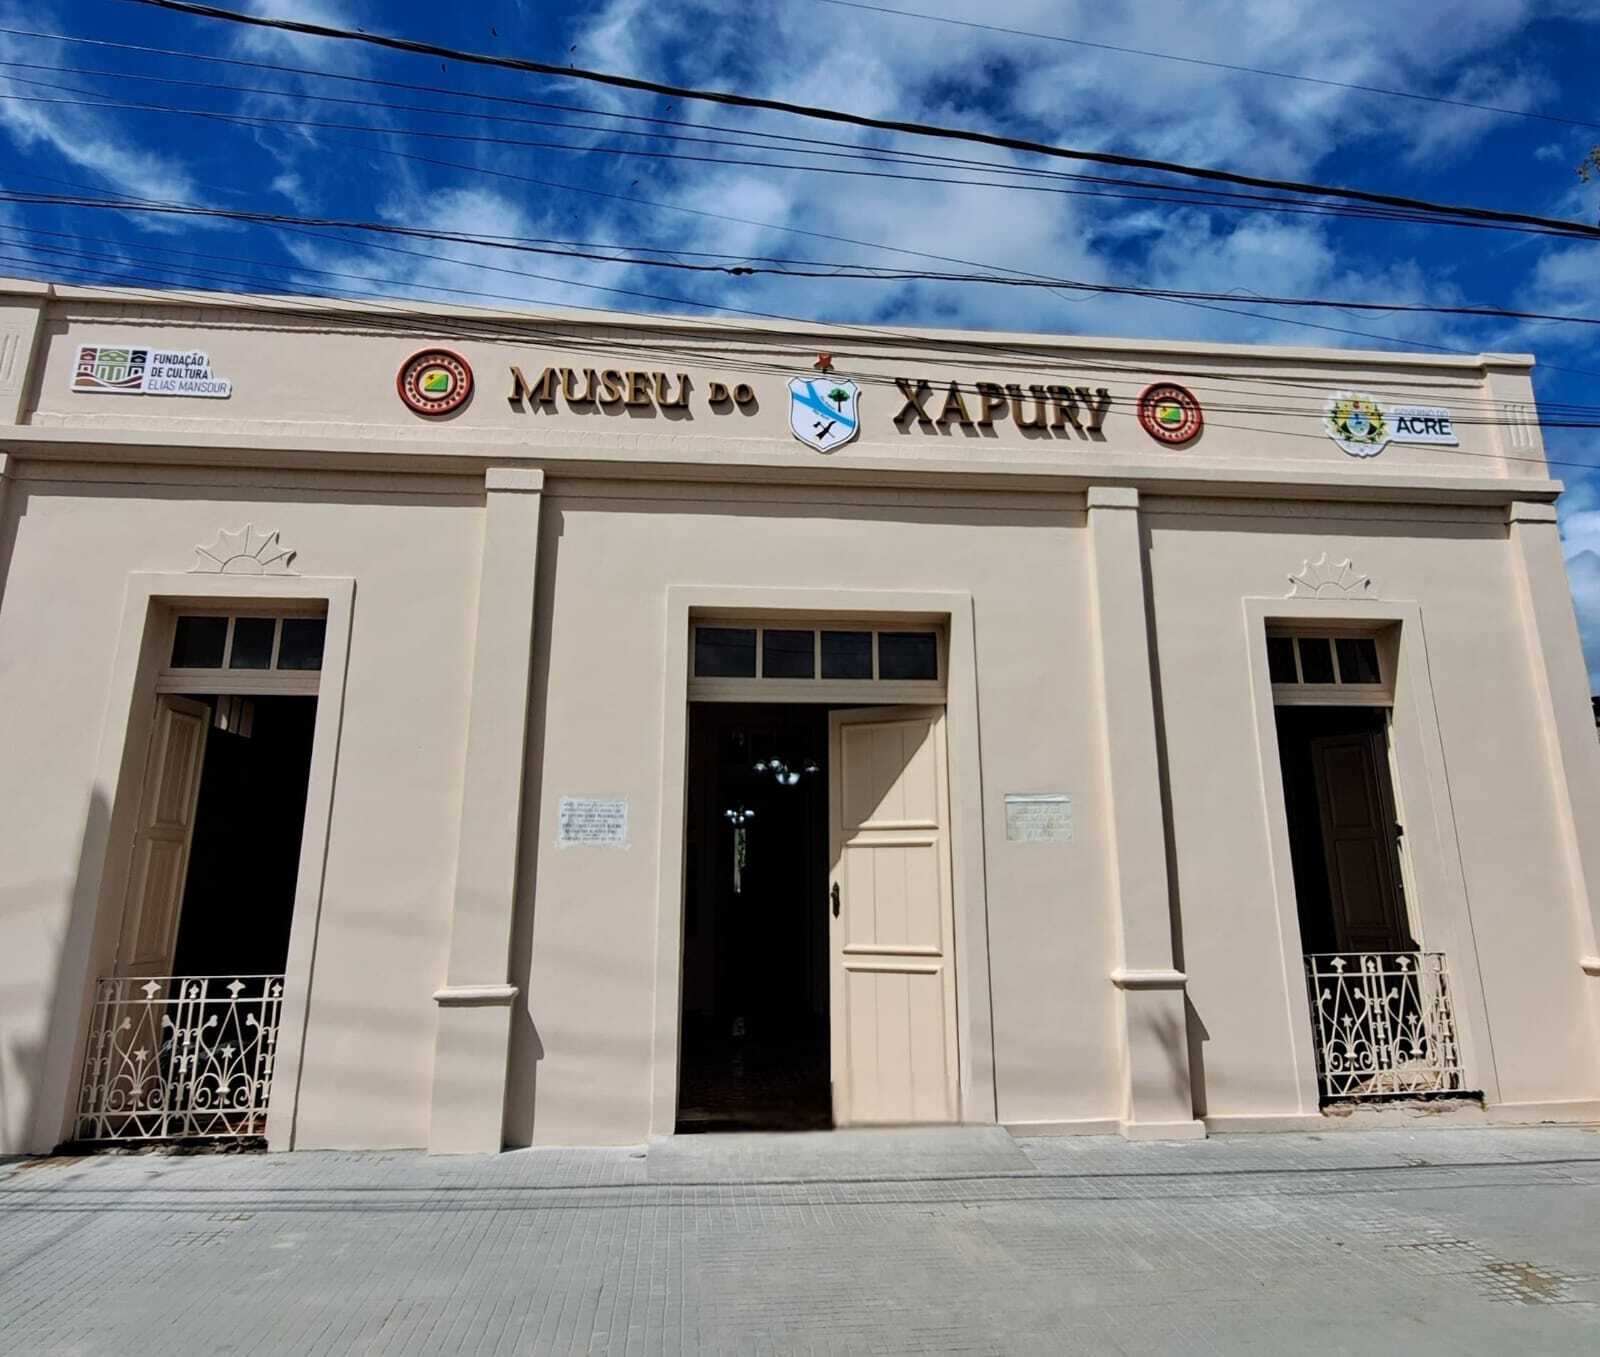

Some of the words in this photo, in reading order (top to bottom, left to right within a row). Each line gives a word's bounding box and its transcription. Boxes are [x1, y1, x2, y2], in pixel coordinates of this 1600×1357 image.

[153, 353, 204, 367] FUNDAÇÃO
[151, 367, 163, 378] DE
[166, 368, 208, 379] CULTURA
[147, 380, 176, 391] ELIAS
[178, 382, 227, 393] MANSOUR
[508, 366, 690, 407] MUSEU
[709, 383, 756, 405] DO
[893, 377, 1112, 433] XAPURY
[1396, 416, 1452, 436] ACRE
